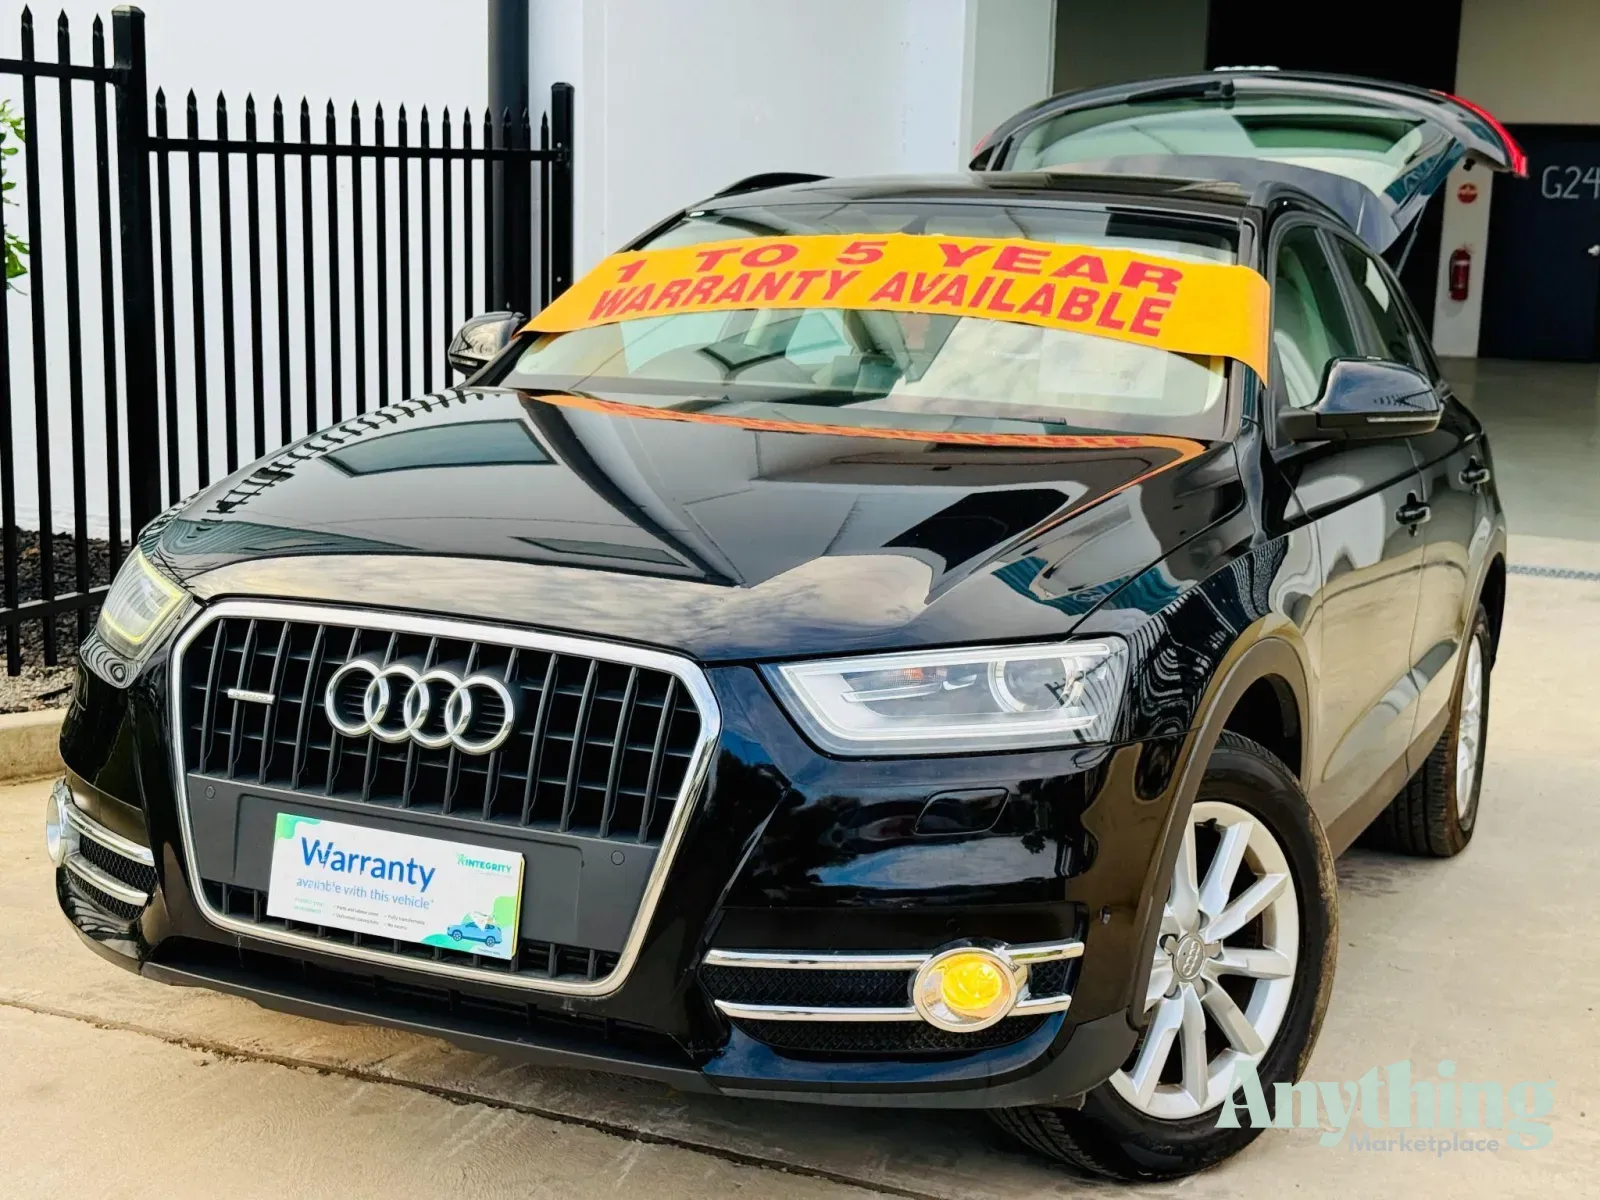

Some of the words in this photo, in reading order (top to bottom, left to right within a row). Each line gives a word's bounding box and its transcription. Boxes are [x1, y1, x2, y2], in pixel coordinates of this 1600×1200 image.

[617, 259, 648, 284] 1
[696, 246, 799, 273] TO
[836, 241, 888, 266] 5
[938, 243, 1184, 295] YEAR
[588, 270, 862, 321] WARRANTY
[868, 271, 1173, 338] AVAILABLE
[301, 836, 437, 893] Warranty
[466, 858, 512, 873] INTEGRITY
[344, 885, 367, 900] with
[370, 889, 389, 903] this
